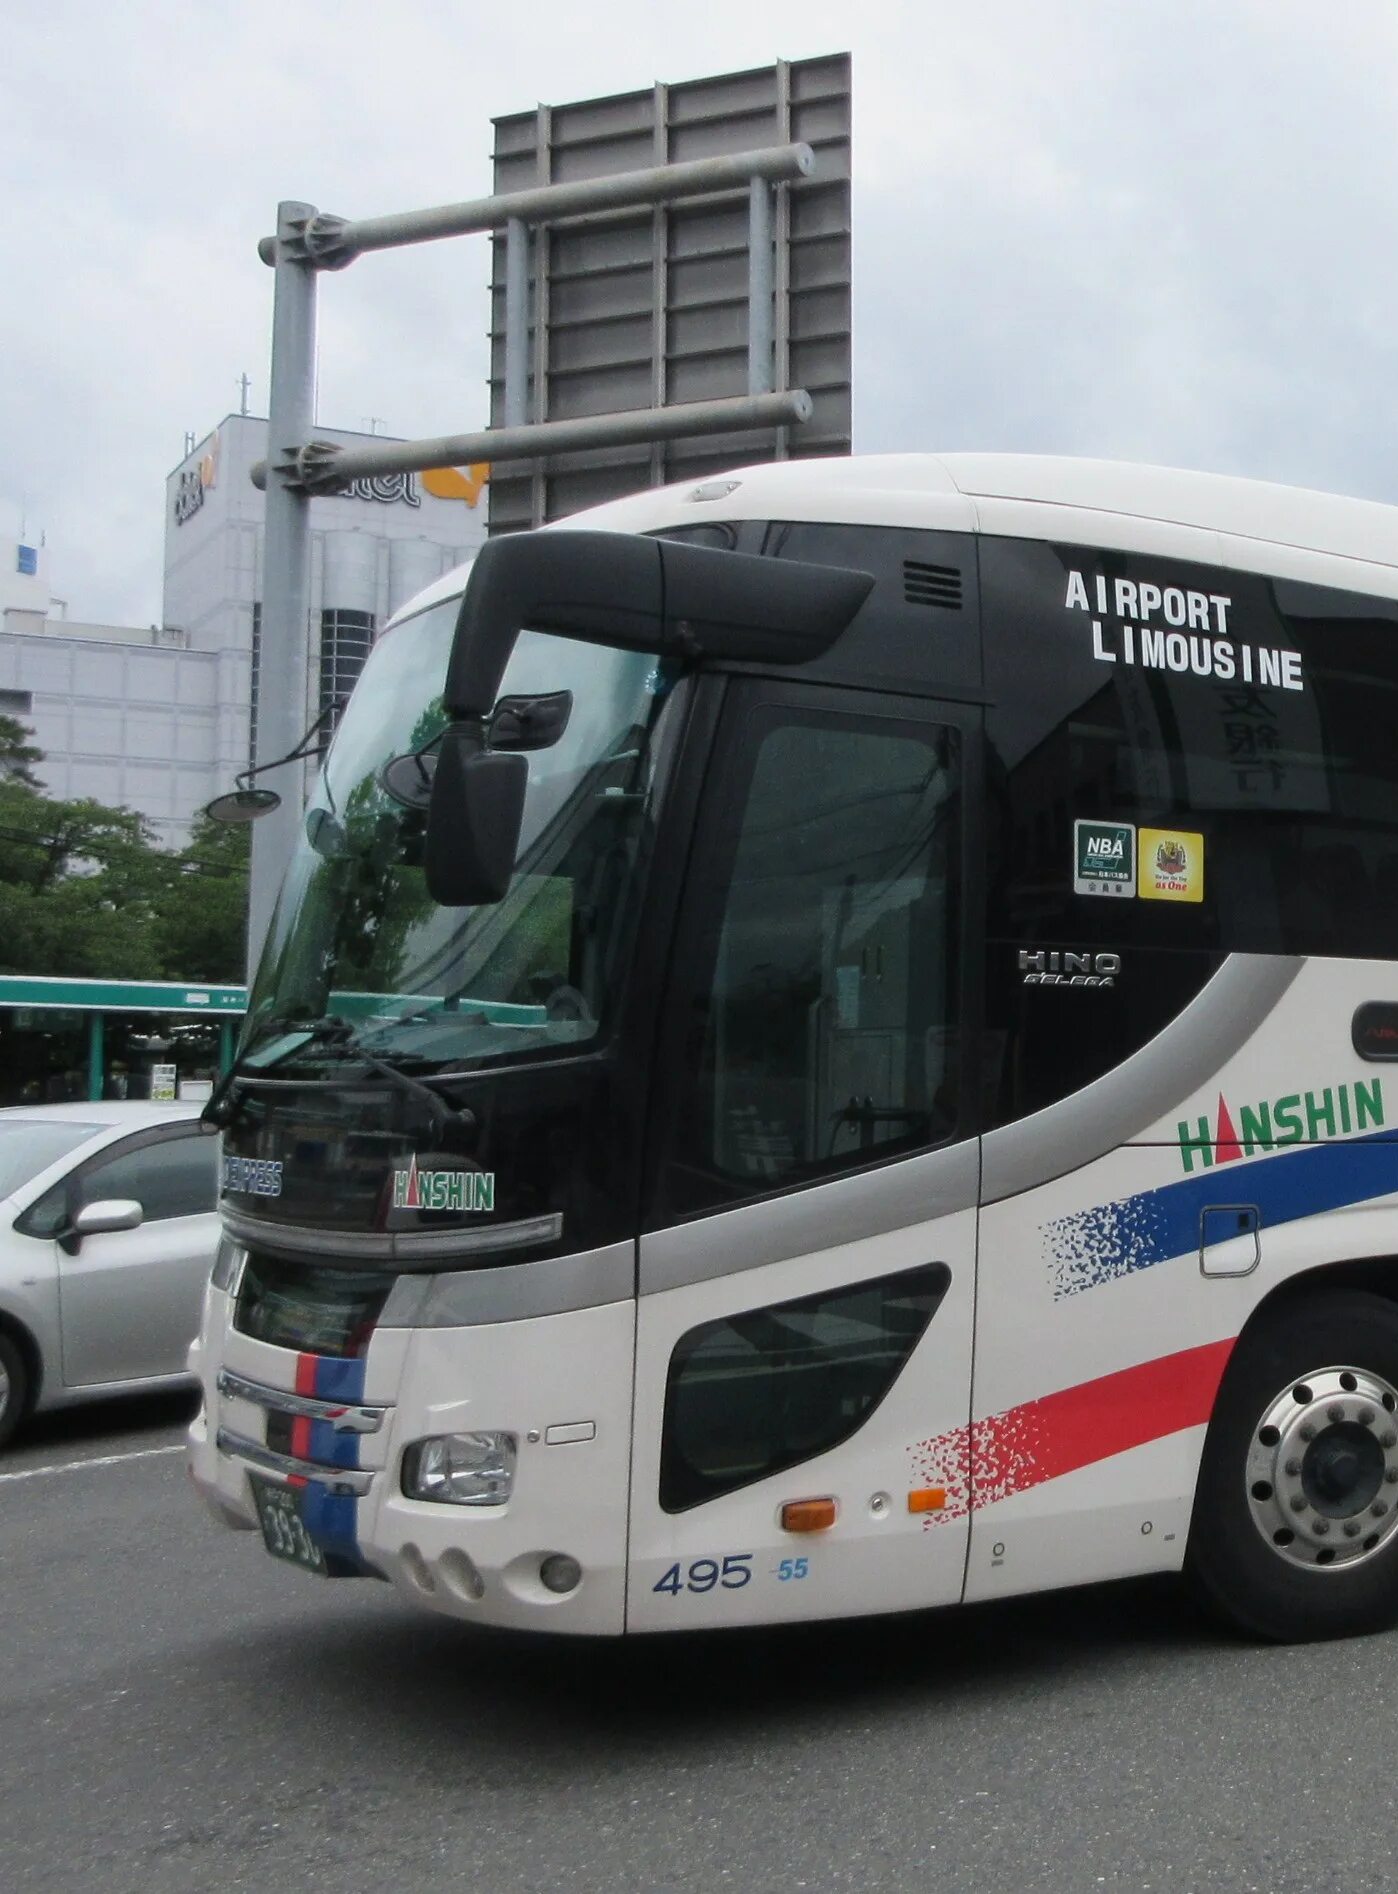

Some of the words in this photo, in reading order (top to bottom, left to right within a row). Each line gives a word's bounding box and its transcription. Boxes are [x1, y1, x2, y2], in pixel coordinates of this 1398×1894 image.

[1065, 570, 1232, 633] AIRPORT
[1092, 620, 1304, 691] LIMOUSINE
[1086, 837, 1123, 855] NBA
[1018, 950, 1121, 975] HINO
[1177, 1077, 1385, 1173] HANSHIN
[393, 1152, 495, 1211] HANSHIN
[652, 1553, 753, 1596] 495
[777, 1556, 808, 1582] 55
